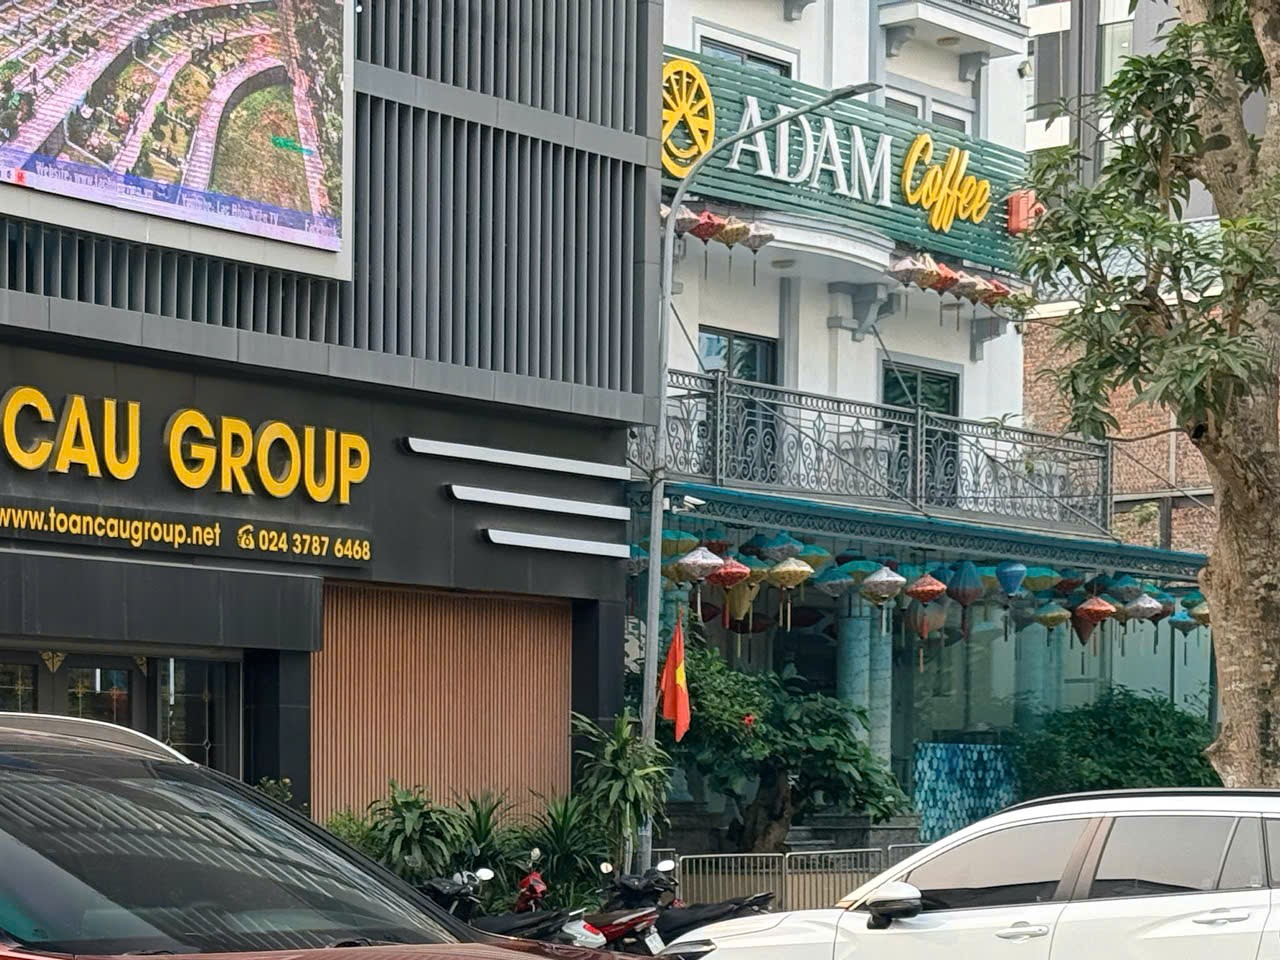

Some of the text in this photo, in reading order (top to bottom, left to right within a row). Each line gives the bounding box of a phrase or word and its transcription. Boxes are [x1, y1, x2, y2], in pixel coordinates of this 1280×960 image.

[723, 96, 992, 233] ADAM Coffee
[0, 385, 141, 482] CAU
[166, 407, 372, 505] GROUP
[257, 528, 289, 552] 024
[291, 533, 329, 555] 3787
[333, 538, 371, 561] 6468
